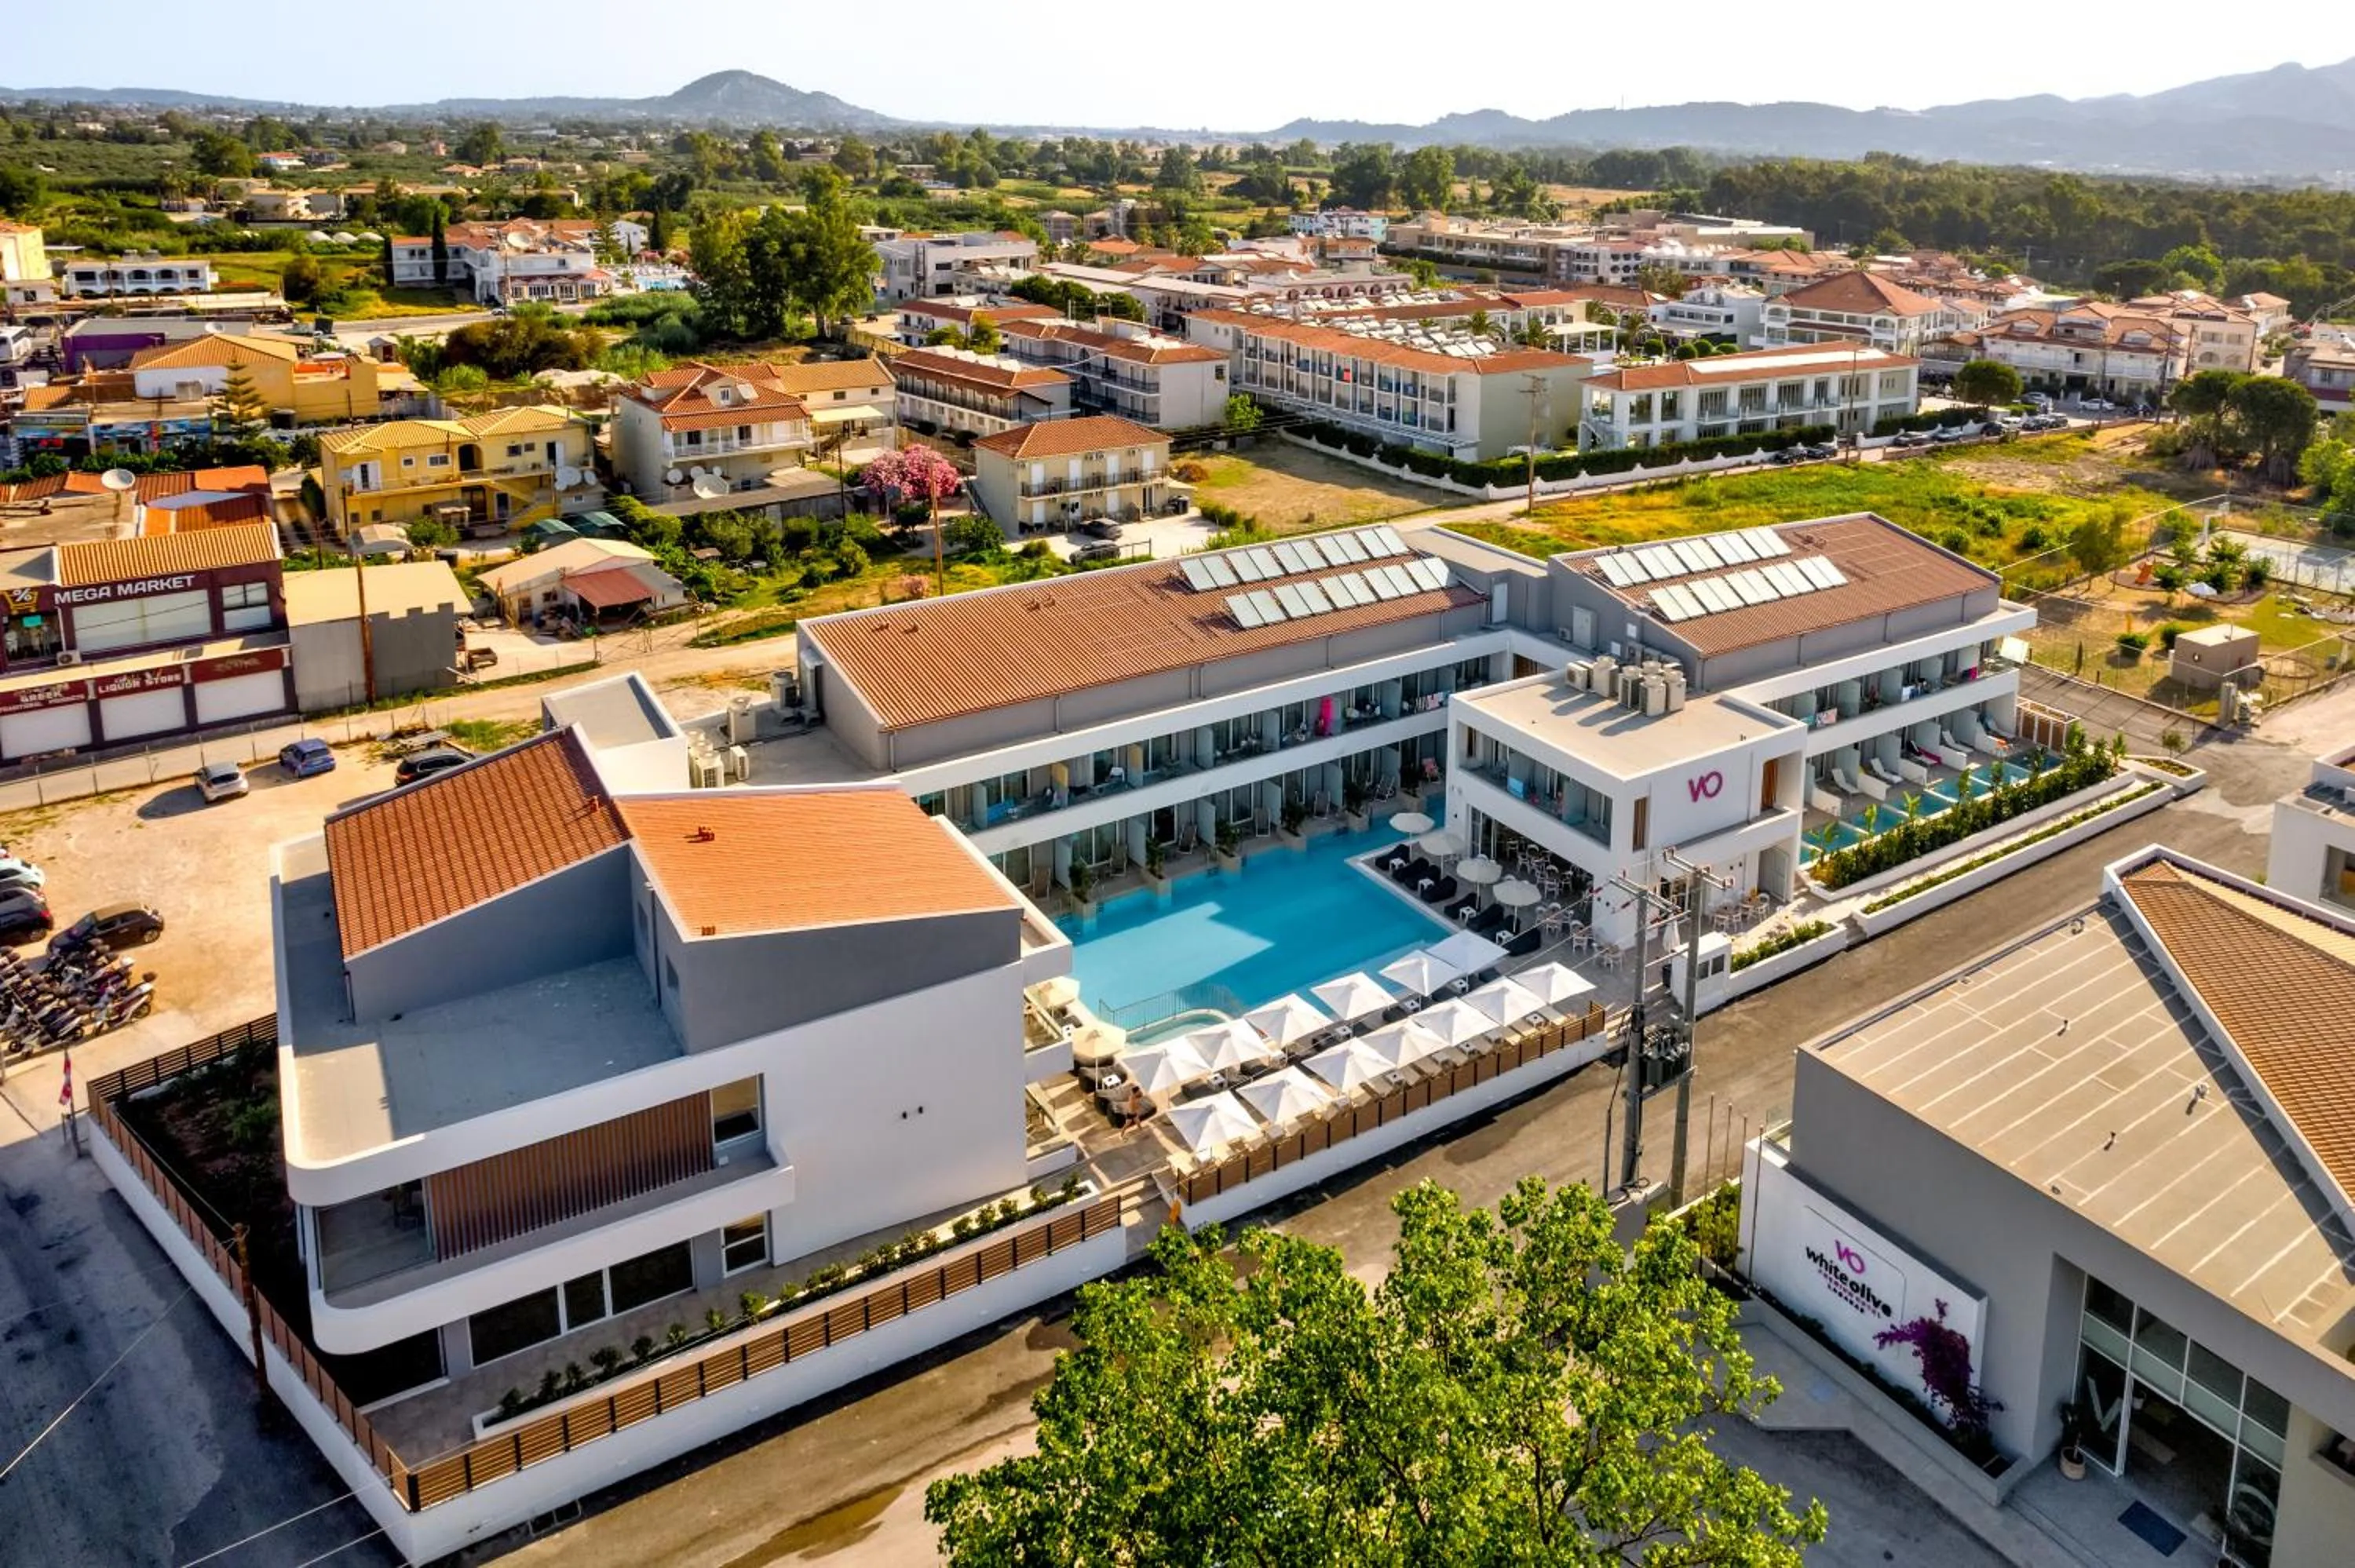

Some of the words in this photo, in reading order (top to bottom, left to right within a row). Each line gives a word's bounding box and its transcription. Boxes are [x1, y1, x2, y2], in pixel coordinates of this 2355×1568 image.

[54, 586, 111, 604] MEGA
[117, 575, 195, 596] MARKET
[98, 680, 141, 694] LIQUOR
[144, 673, 181, 686] STORE
